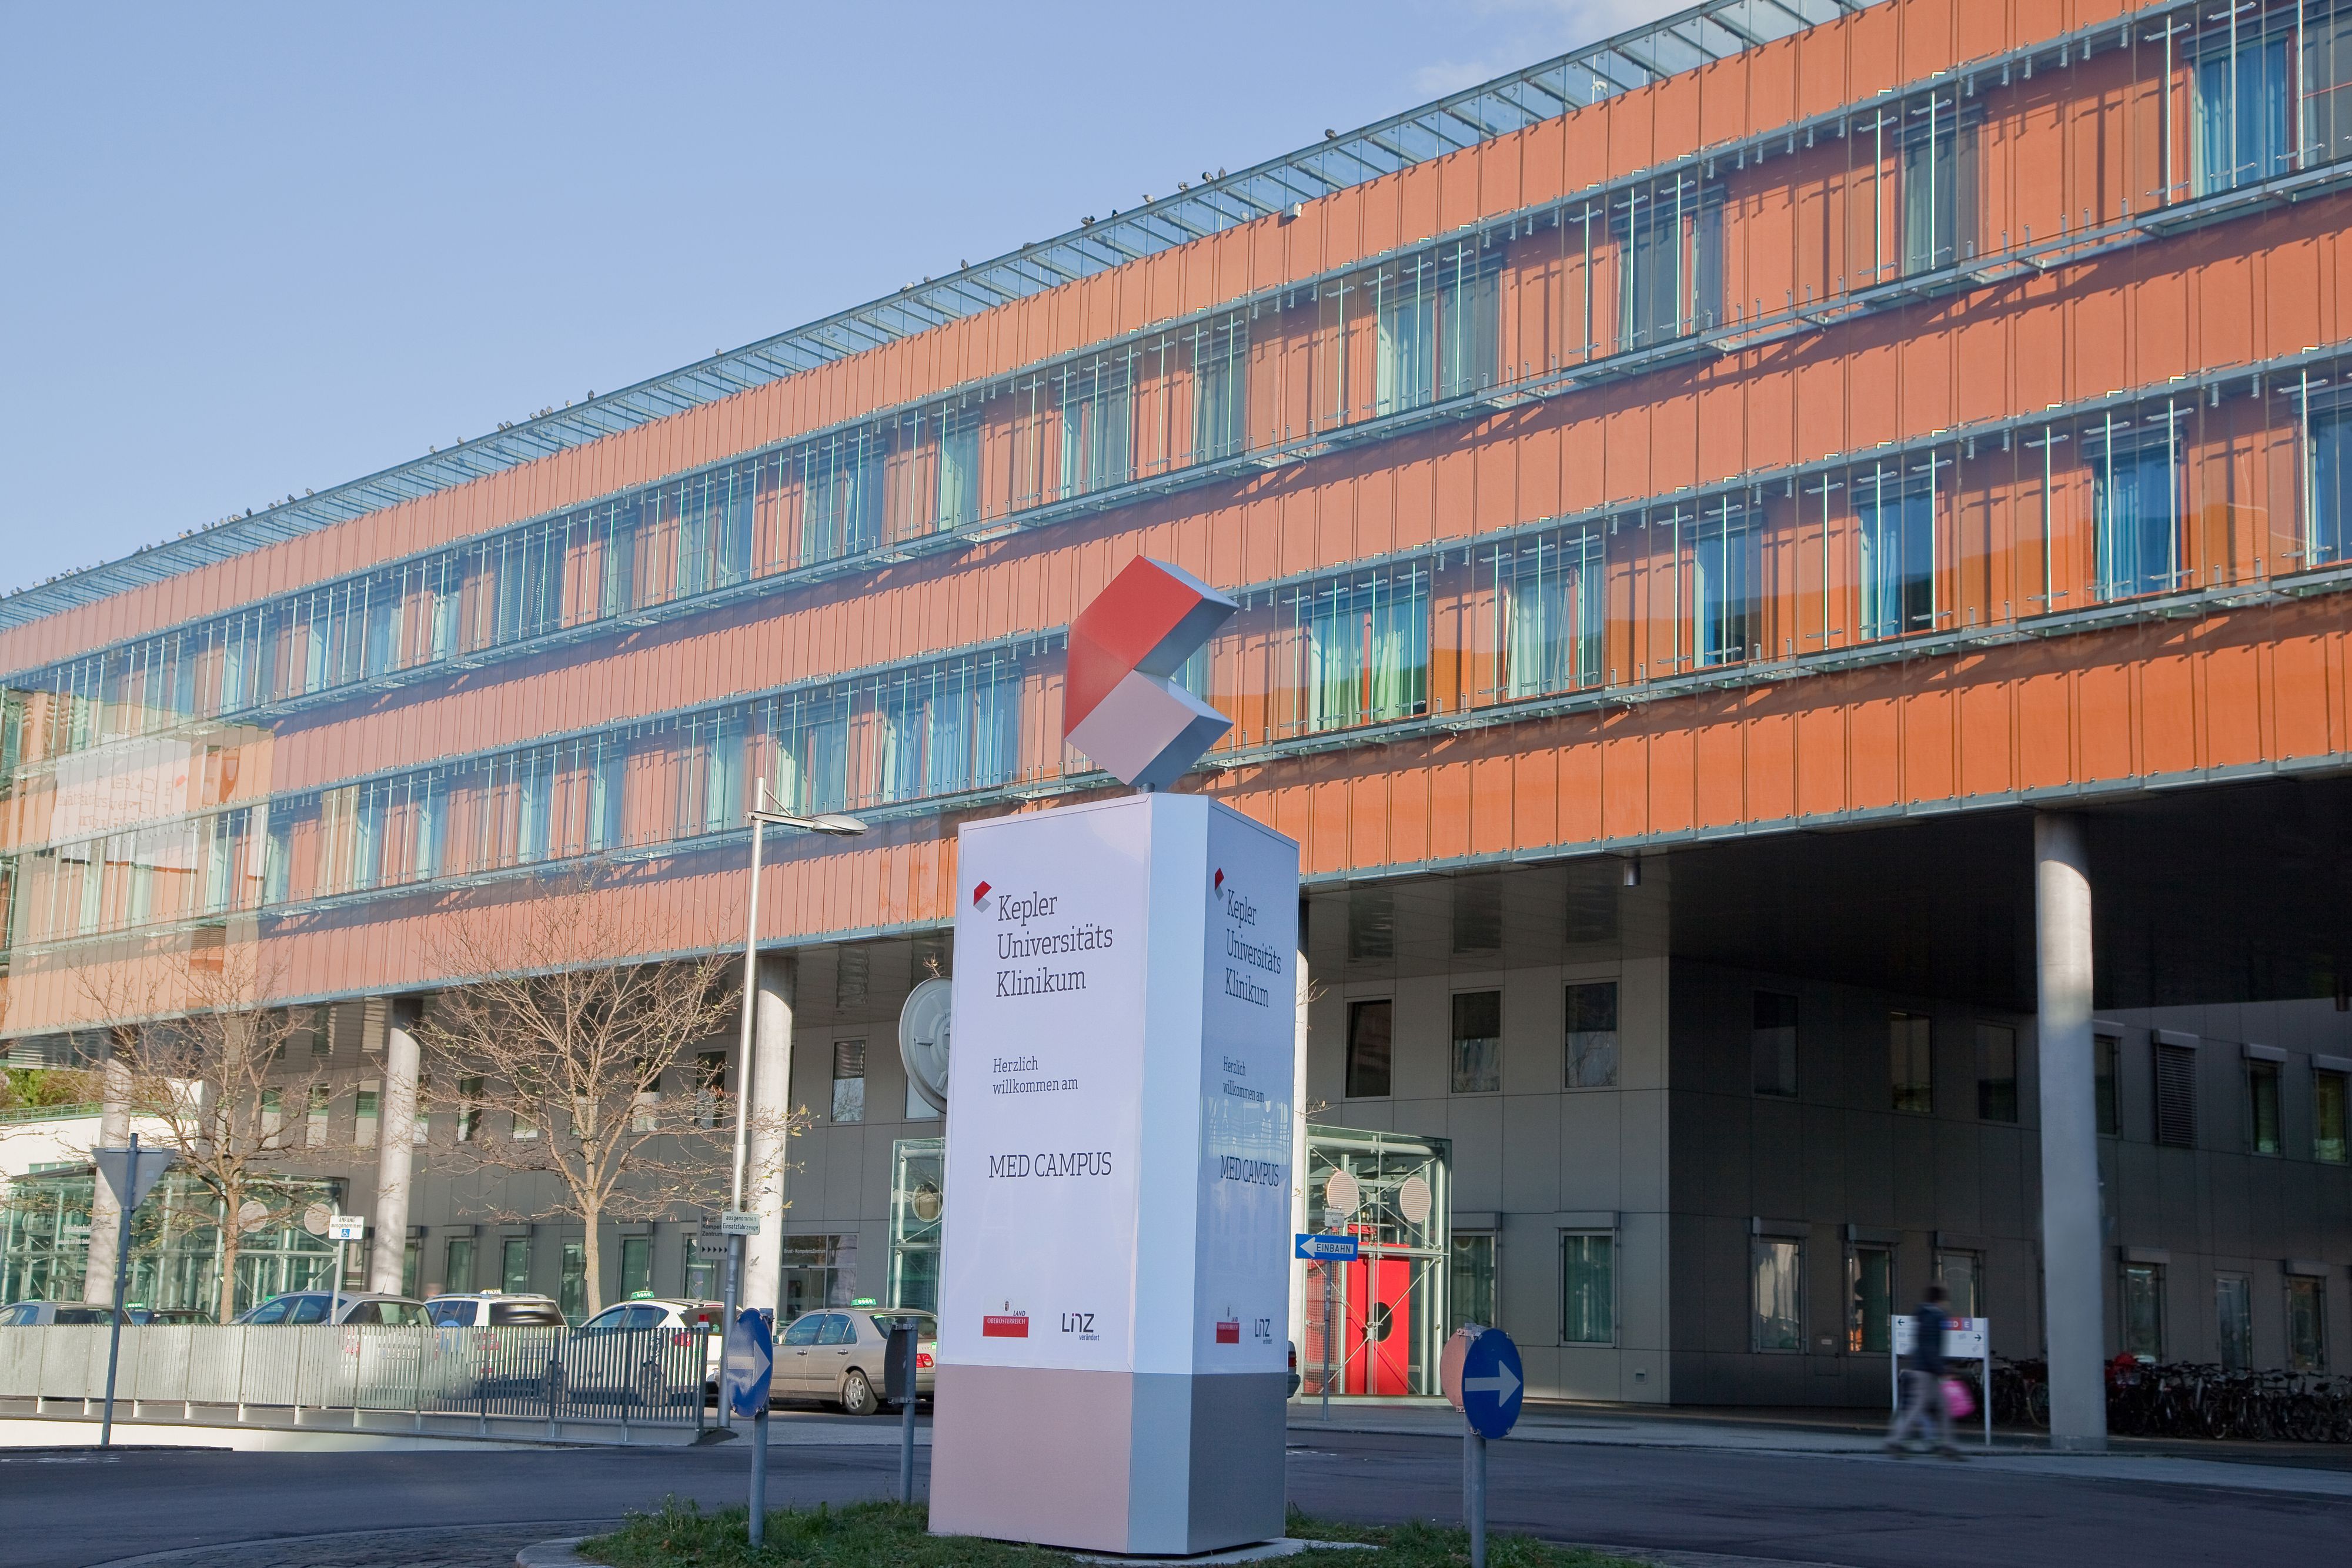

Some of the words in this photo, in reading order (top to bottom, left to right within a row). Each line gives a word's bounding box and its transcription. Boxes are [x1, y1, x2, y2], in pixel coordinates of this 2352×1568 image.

[997, 891, 1058, 927] Kepler
[1227, 889, 1257, 929] Kepler
[997, 922, 1114, 959] Universitäts
[1227, 928, 1281, 974] Universitäts
[996, 967, 1087, 998] Klinikum
[1225, 968, 1269, 1008] Klinikum
[993, 1056, 1038, 1073] Herzlich
[1223, 1056, 1246, 1077] Herzlich
[993, 1079, 1060, 1095] willkommen
[1061, 1080, 1078, 1091] am
[1223, 1080, 1255, 1102] willkommen
[1256, 1091, 1264, 1103] am
[989, 1154, 1030, 1178] MED
[1034, 1152, 1111, 1177] CAMPUS
[1220, 1155, 1241, 1181] MED
[1243, 1159, 1279, 1187] CAMPUS
[723, 1223, 759, 1231] Einsatzfahrzeuge
[1317, 1243, 1351, 1253] EINBAHN
